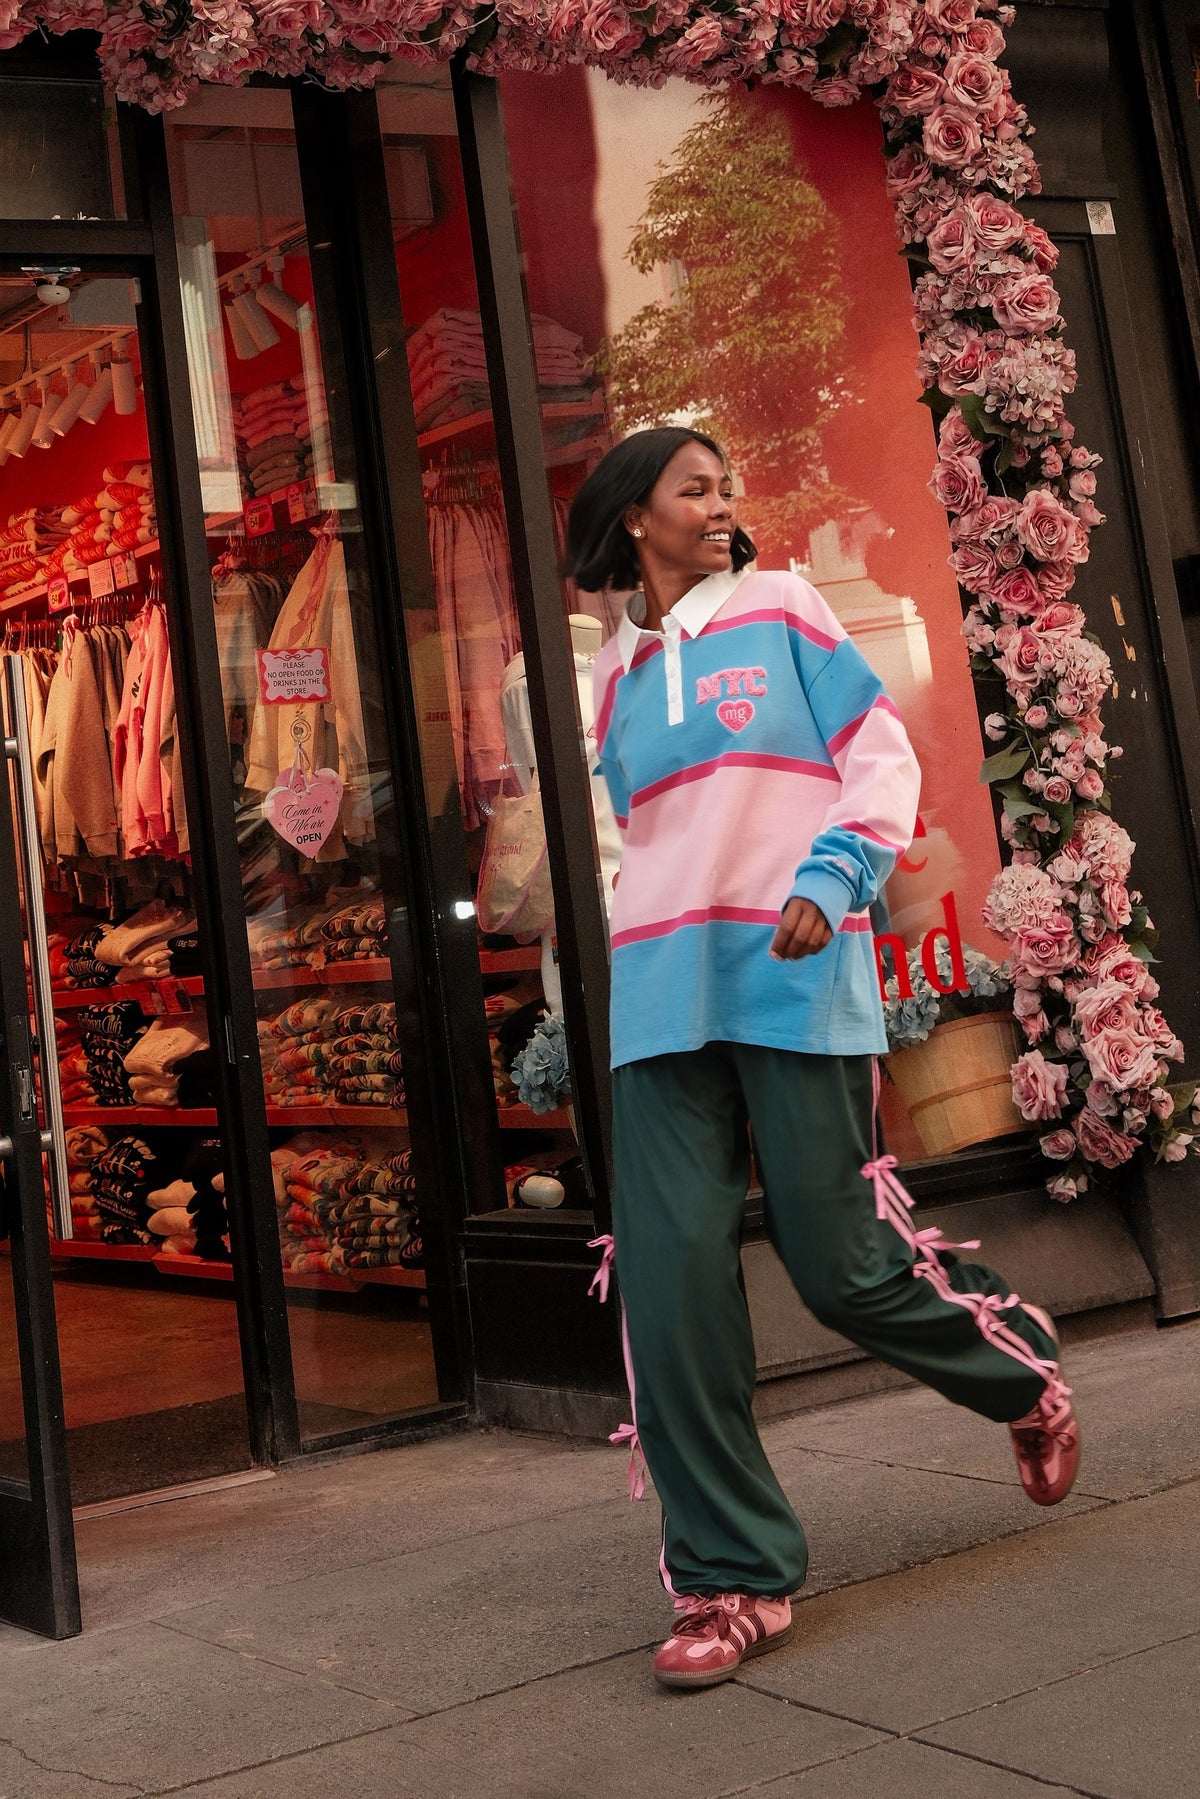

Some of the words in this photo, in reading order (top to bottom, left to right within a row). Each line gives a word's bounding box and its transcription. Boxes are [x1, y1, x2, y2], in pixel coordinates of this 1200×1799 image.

[282, 661, 305, 669] PLEASE
[273, 679, 298, 687] DRINKS
[696, 666, 768, 705] NYC
[725, 706, 747, 722] mg
[282, 804, 310, 819] Come
[285, 815, 316, 834] We
[310, 820, 325, 830] are
[296, 833, 322, 845] OPEN
